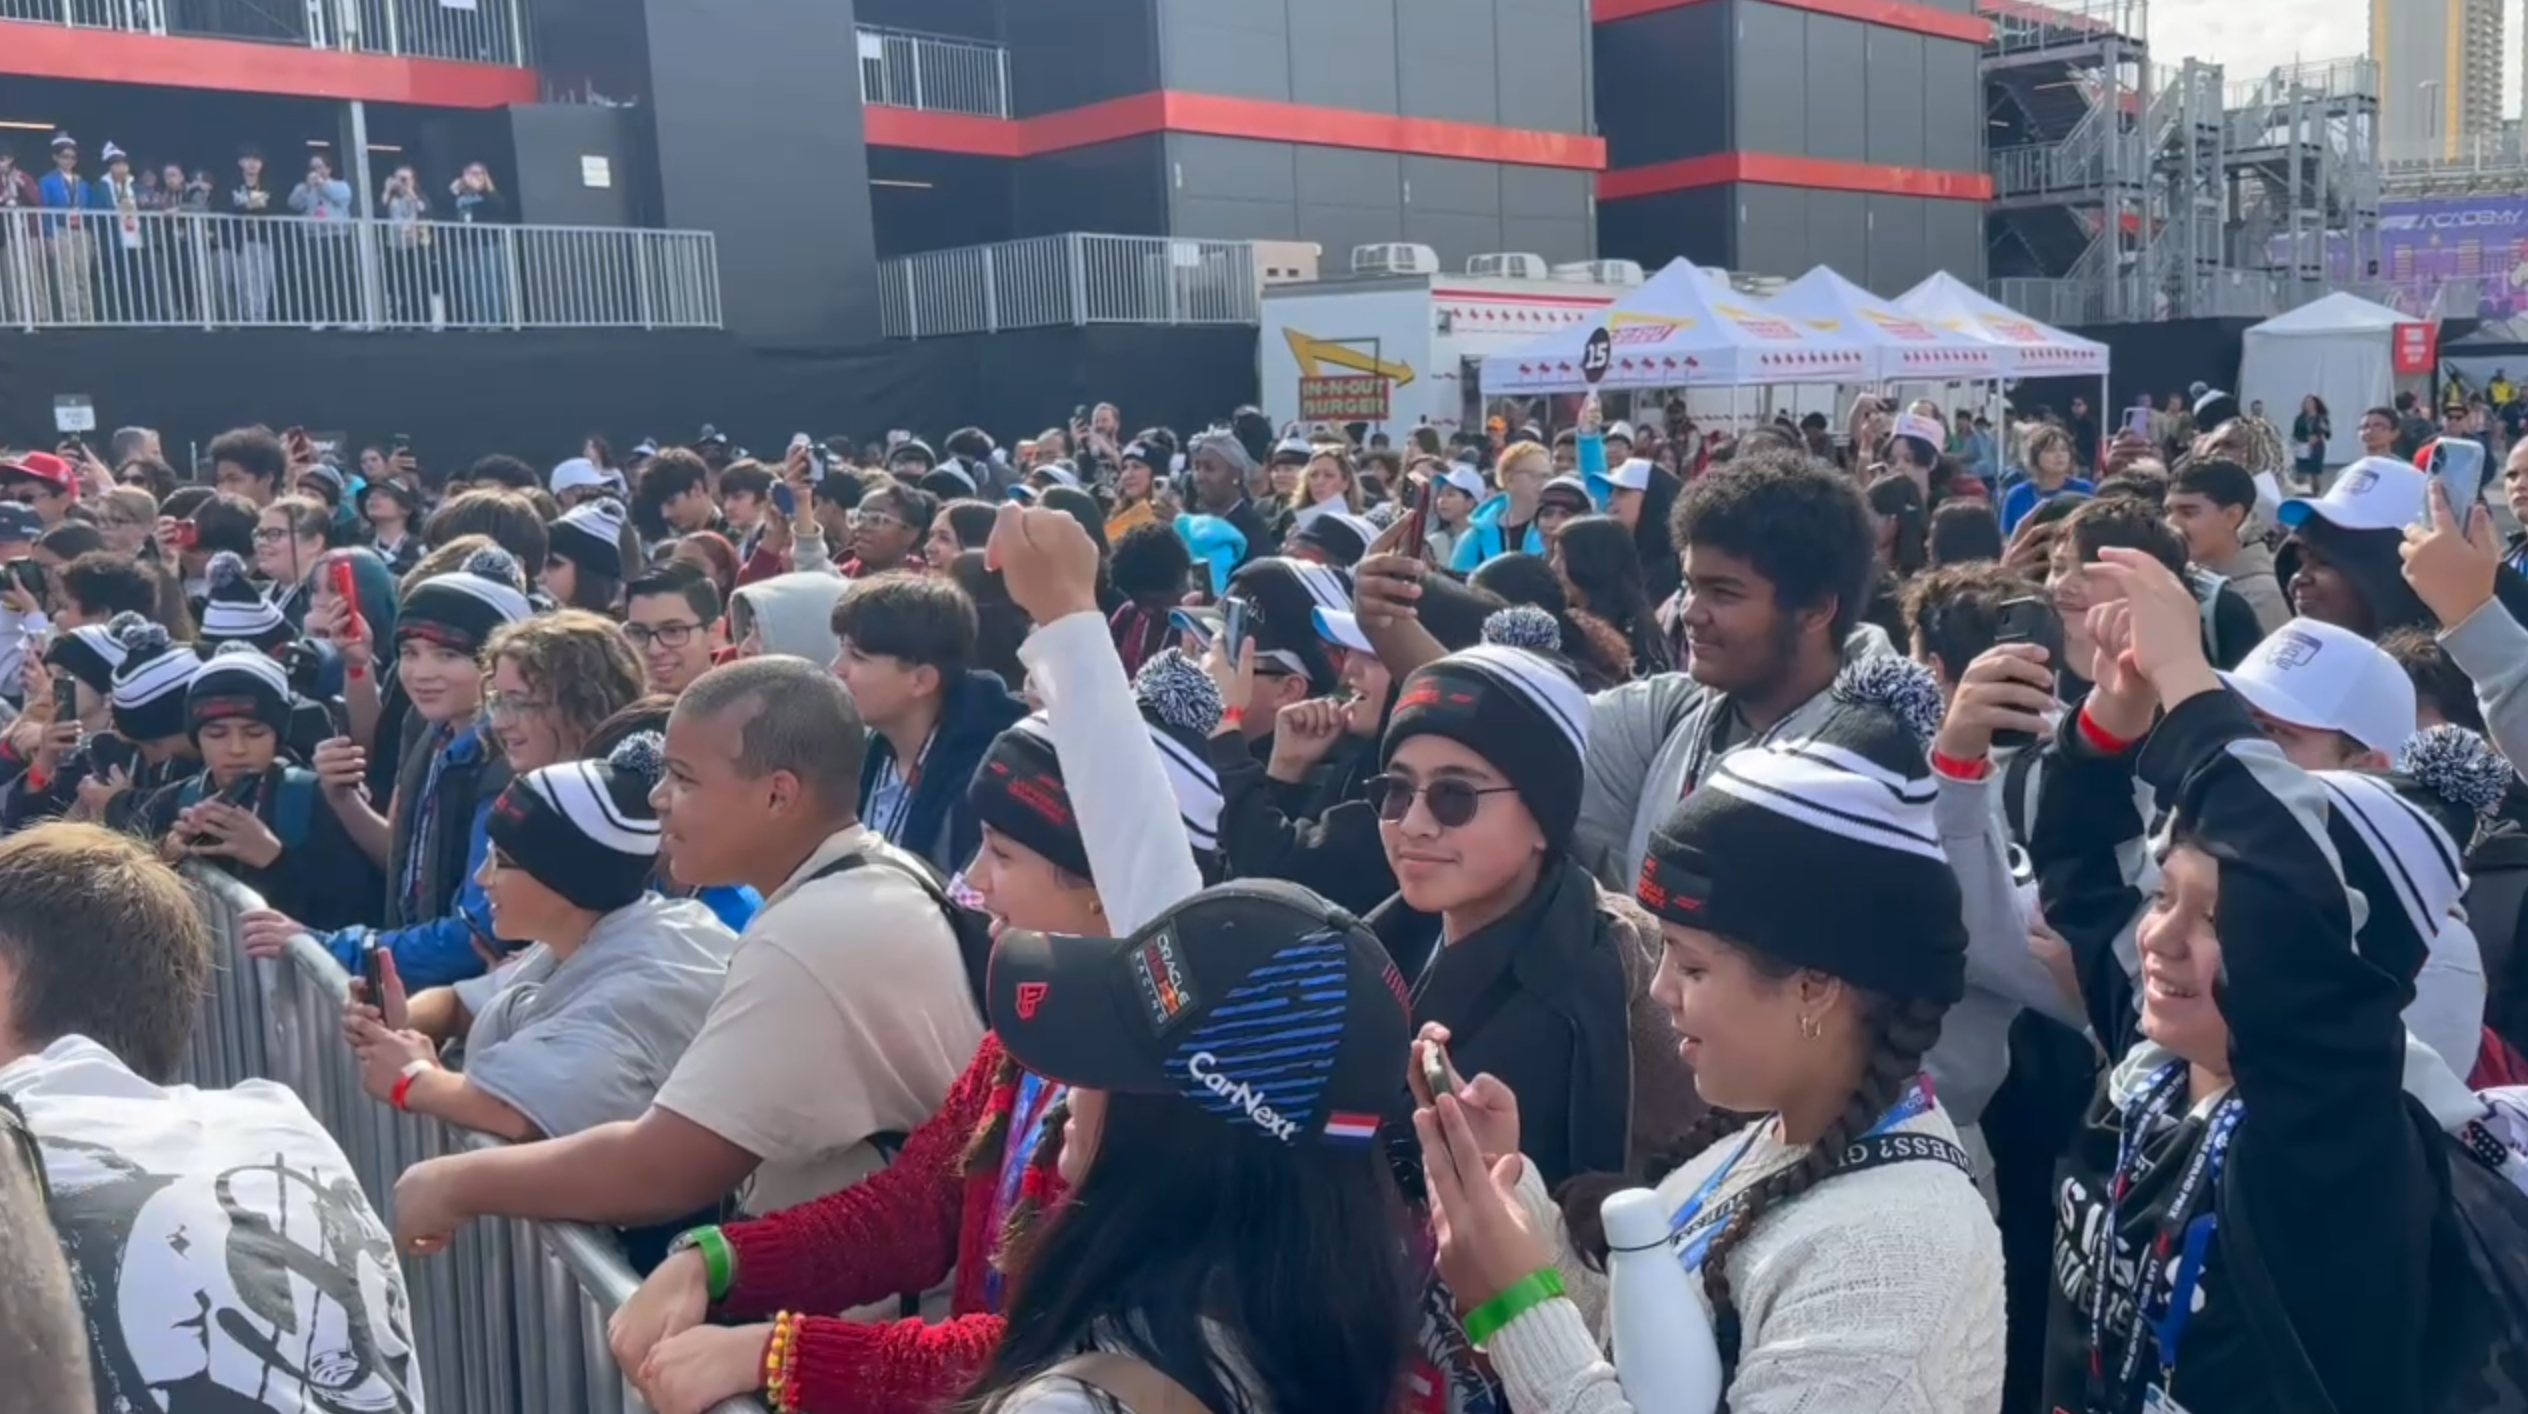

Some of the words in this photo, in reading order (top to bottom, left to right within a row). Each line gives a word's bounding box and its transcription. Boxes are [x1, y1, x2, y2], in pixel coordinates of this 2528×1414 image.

[2419, 209, 2524, 230] ACADEMY
[1586, 341, 1609, 369] 15
[1303, 380, 1386, 396] IN-N-OUT
[1303, 398, 1385, 415] BURGER
[1157, 933, 1191, 1007] ORACLE
[1135, 951, 1165, 1024] RACING
[1188, 1050, 1297, 1141] CarNext
[1880, 1137, 1976, 1178] UESS?
